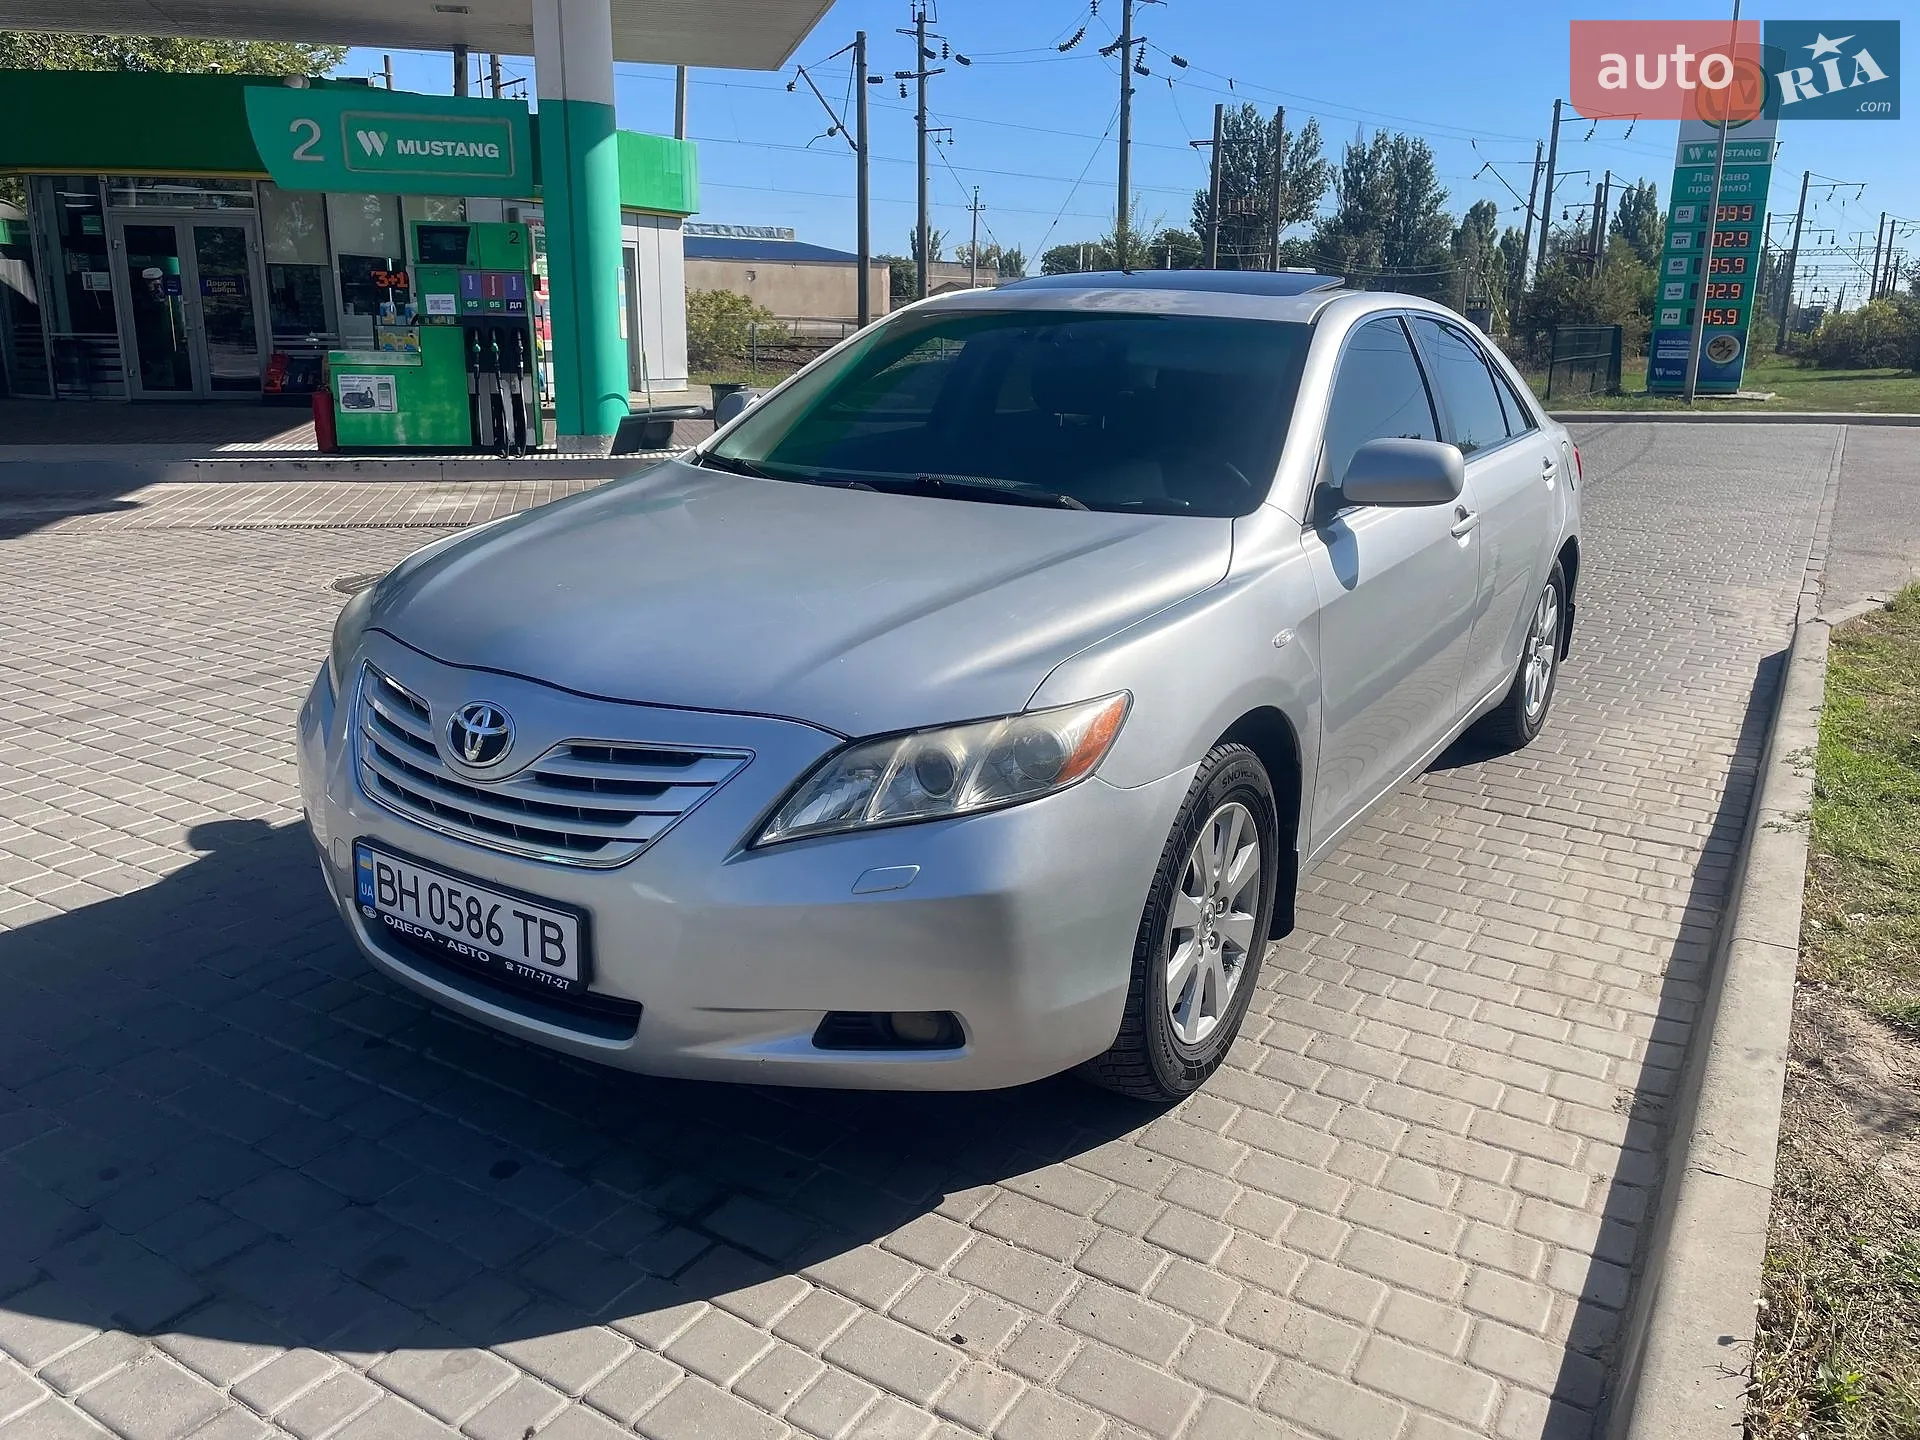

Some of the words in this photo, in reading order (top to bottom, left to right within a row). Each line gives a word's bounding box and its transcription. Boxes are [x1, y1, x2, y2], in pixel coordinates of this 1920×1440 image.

[290, 119, 325, 161] 2
[397, 139, 500, 158] MUSTANG
[1708, 149, 1761, 158] MSTANG
[1688, 183, 1752, 195] проимо!
[508, 230, 521, 244] 2
[376, 271, 408, 288] 3+1
[510, 301, 522, 309] ДП
[361, 882, 374, 899] UA
[377, 861, 420, 918] BH
[428, 882, 504, 947] 0586
[513, 909, 567, 968] TB
[384, 914, 435, 942] ОДЕСА
[447, 939, 490, 962] АВТО
[516, 964, 570, 991] 777-77-27
